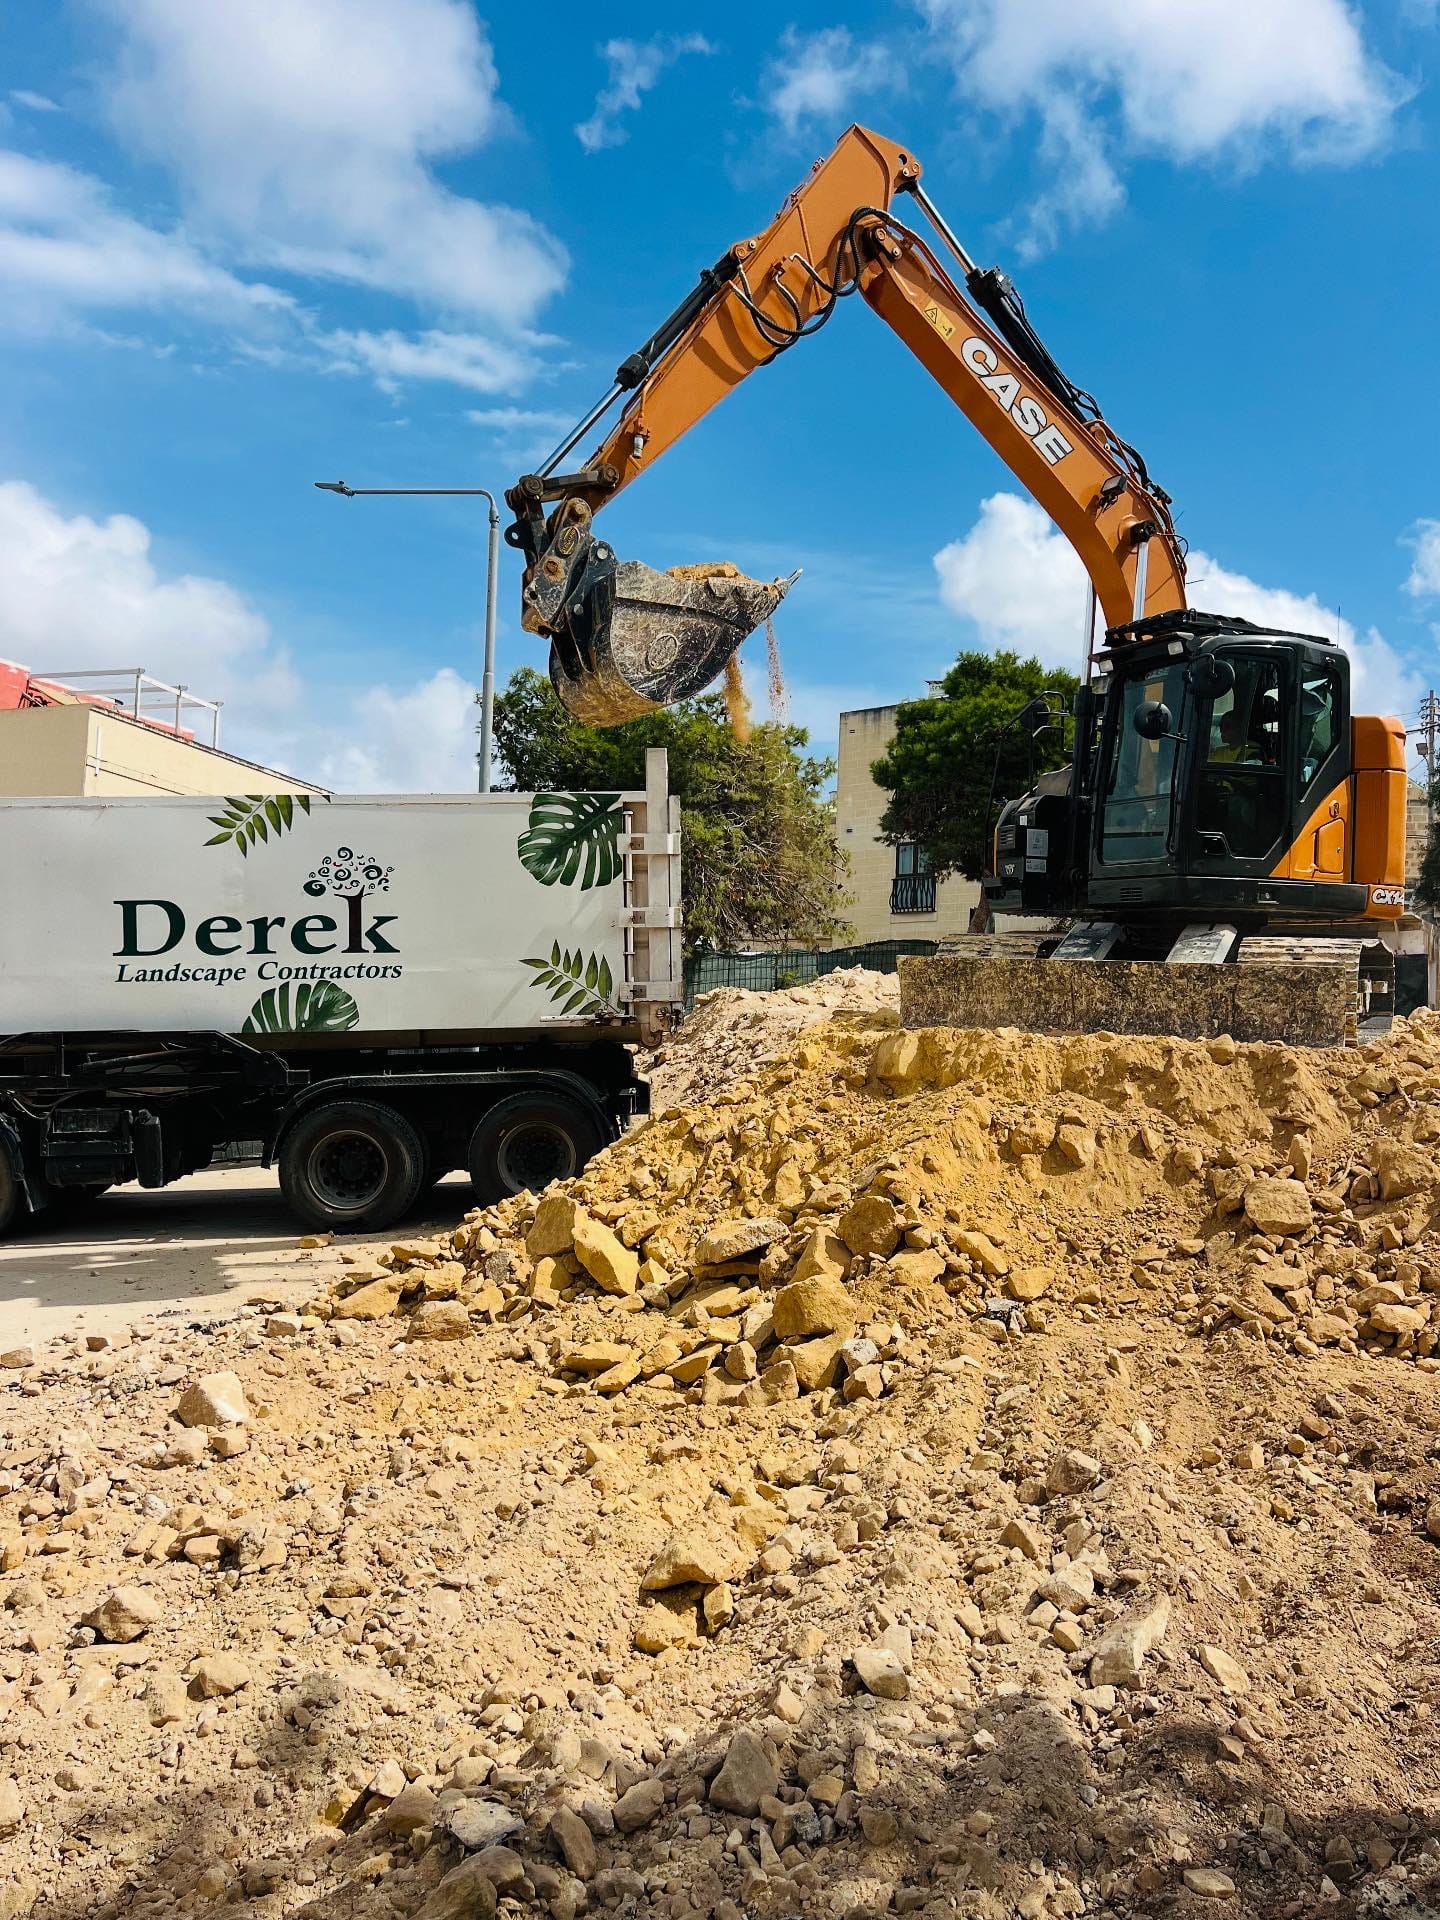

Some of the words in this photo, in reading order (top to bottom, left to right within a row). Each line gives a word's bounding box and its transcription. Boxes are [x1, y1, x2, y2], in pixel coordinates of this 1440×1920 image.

[960, 336, 1075, 467] CASE
[112, 894, 401, 957] Derek
[114, 963, 247, 987] Landscape
[257, 961, 403, 981] Contractors
